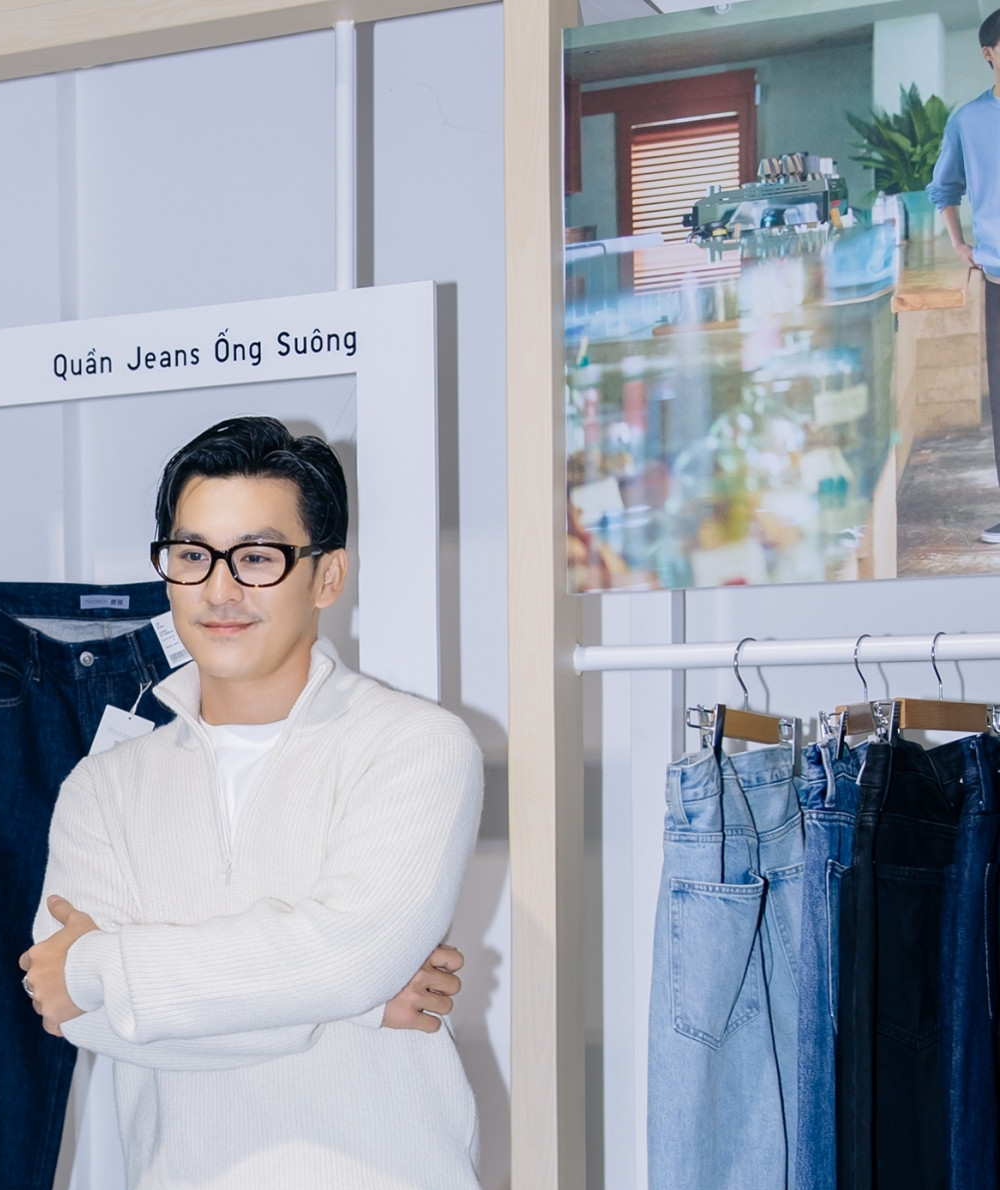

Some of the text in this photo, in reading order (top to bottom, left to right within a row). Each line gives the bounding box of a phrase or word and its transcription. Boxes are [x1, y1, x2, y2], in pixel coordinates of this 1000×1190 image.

[53, 328, 358, 381] Quần Jeans Ống Suông
